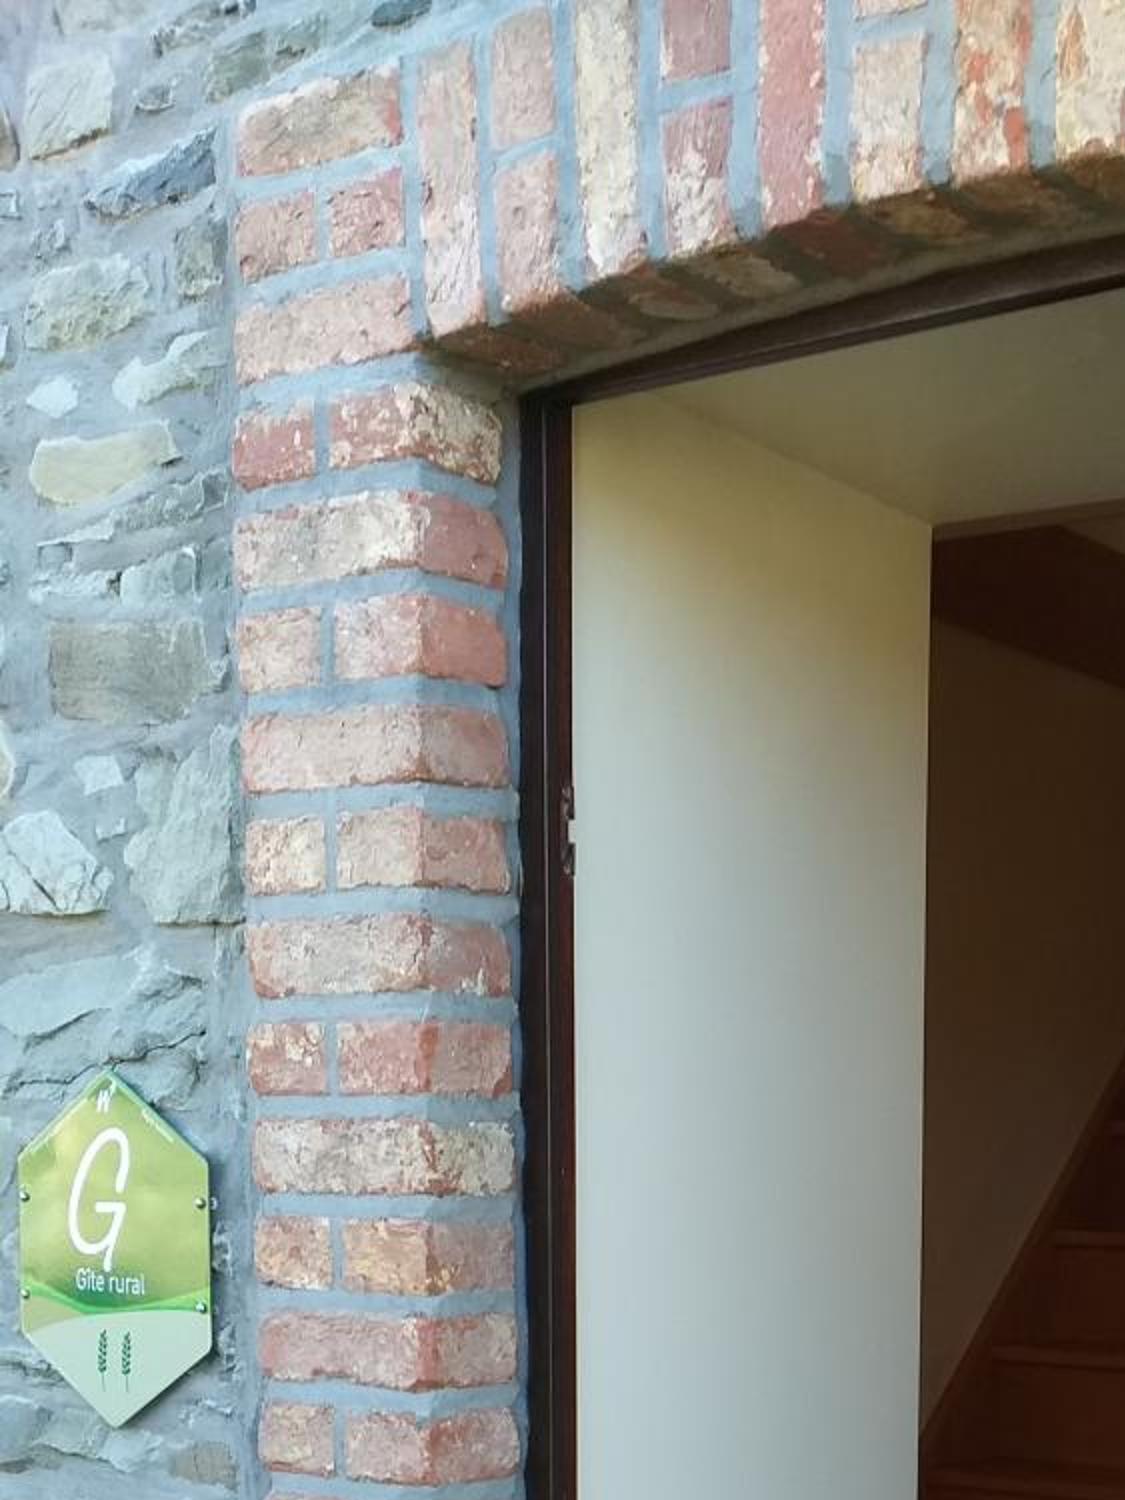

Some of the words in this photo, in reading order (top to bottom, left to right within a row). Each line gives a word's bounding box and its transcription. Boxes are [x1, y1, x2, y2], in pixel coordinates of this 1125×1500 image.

[68, 1127, 130, 1272] G
[76, 1267, 104, 1292] Gîte
[109, 1272, 145, 1296] rural
